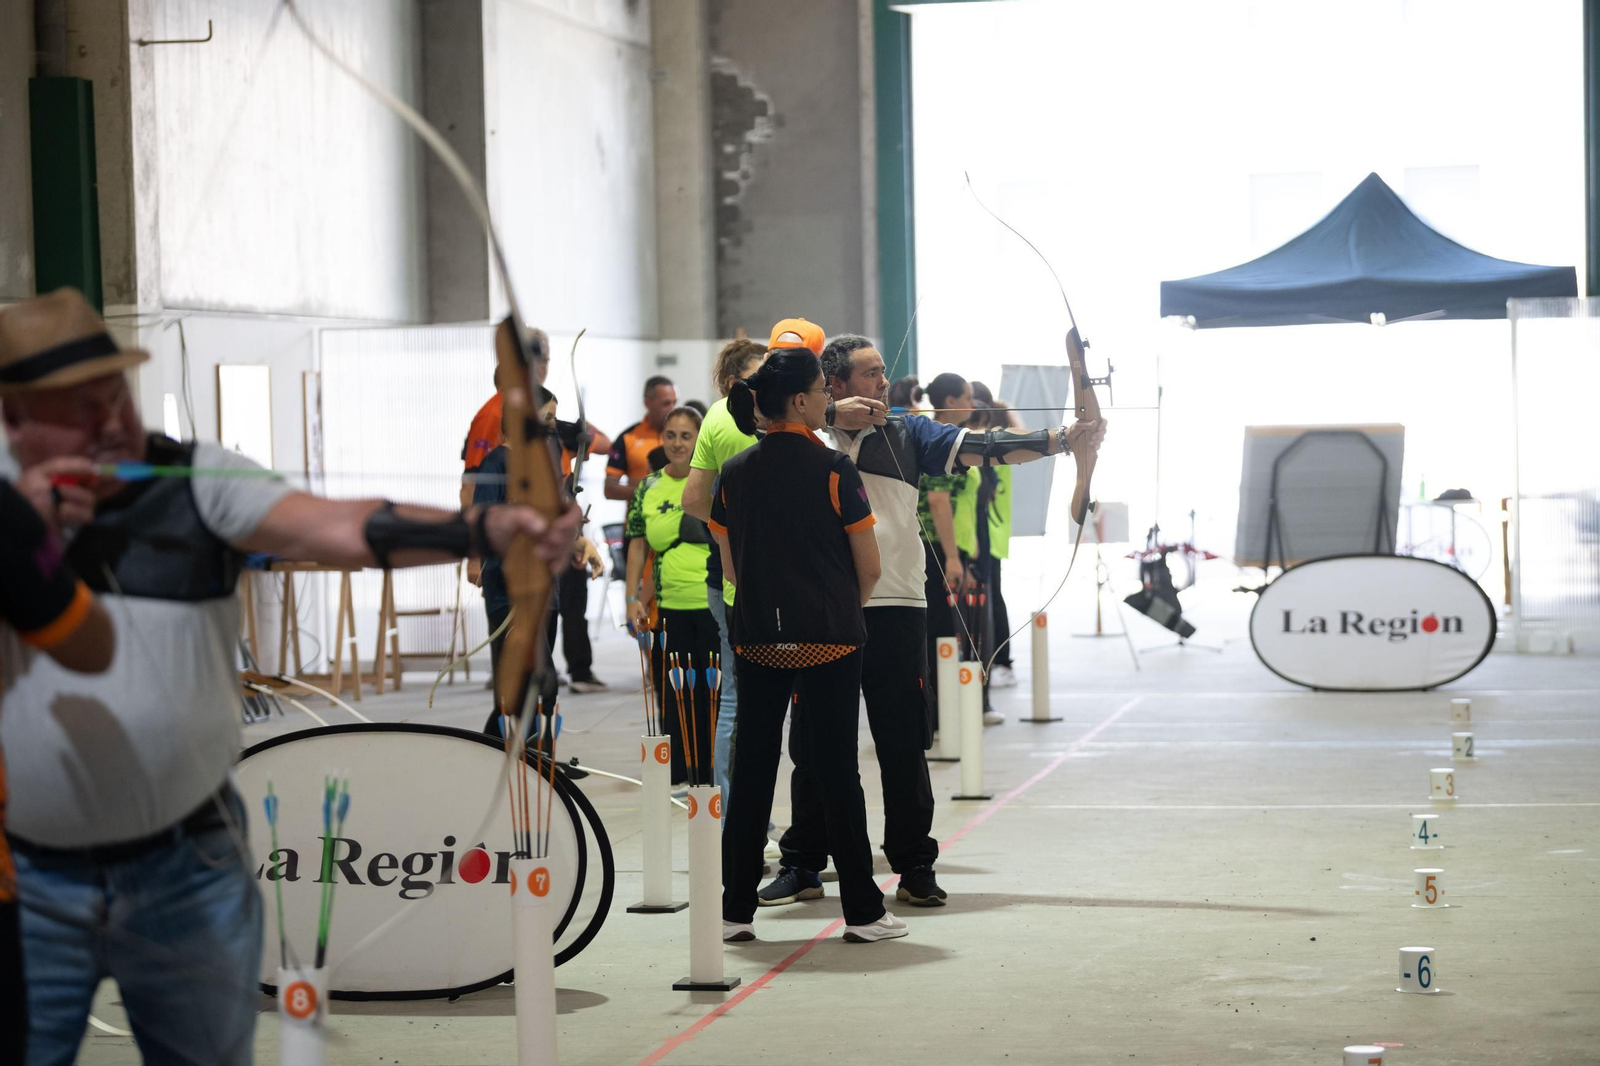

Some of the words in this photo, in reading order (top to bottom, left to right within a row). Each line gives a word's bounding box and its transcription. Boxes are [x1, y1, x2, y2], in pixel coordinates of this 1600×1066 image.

[1282, 609, 1328, 634] La
[660, 747, 668, 760] 5
[714, 799, 721, 814] 6
[255, 847, 301, 882] a
[535, 872, 547, 891] 7
[291, 991, 309, 1011] 8
